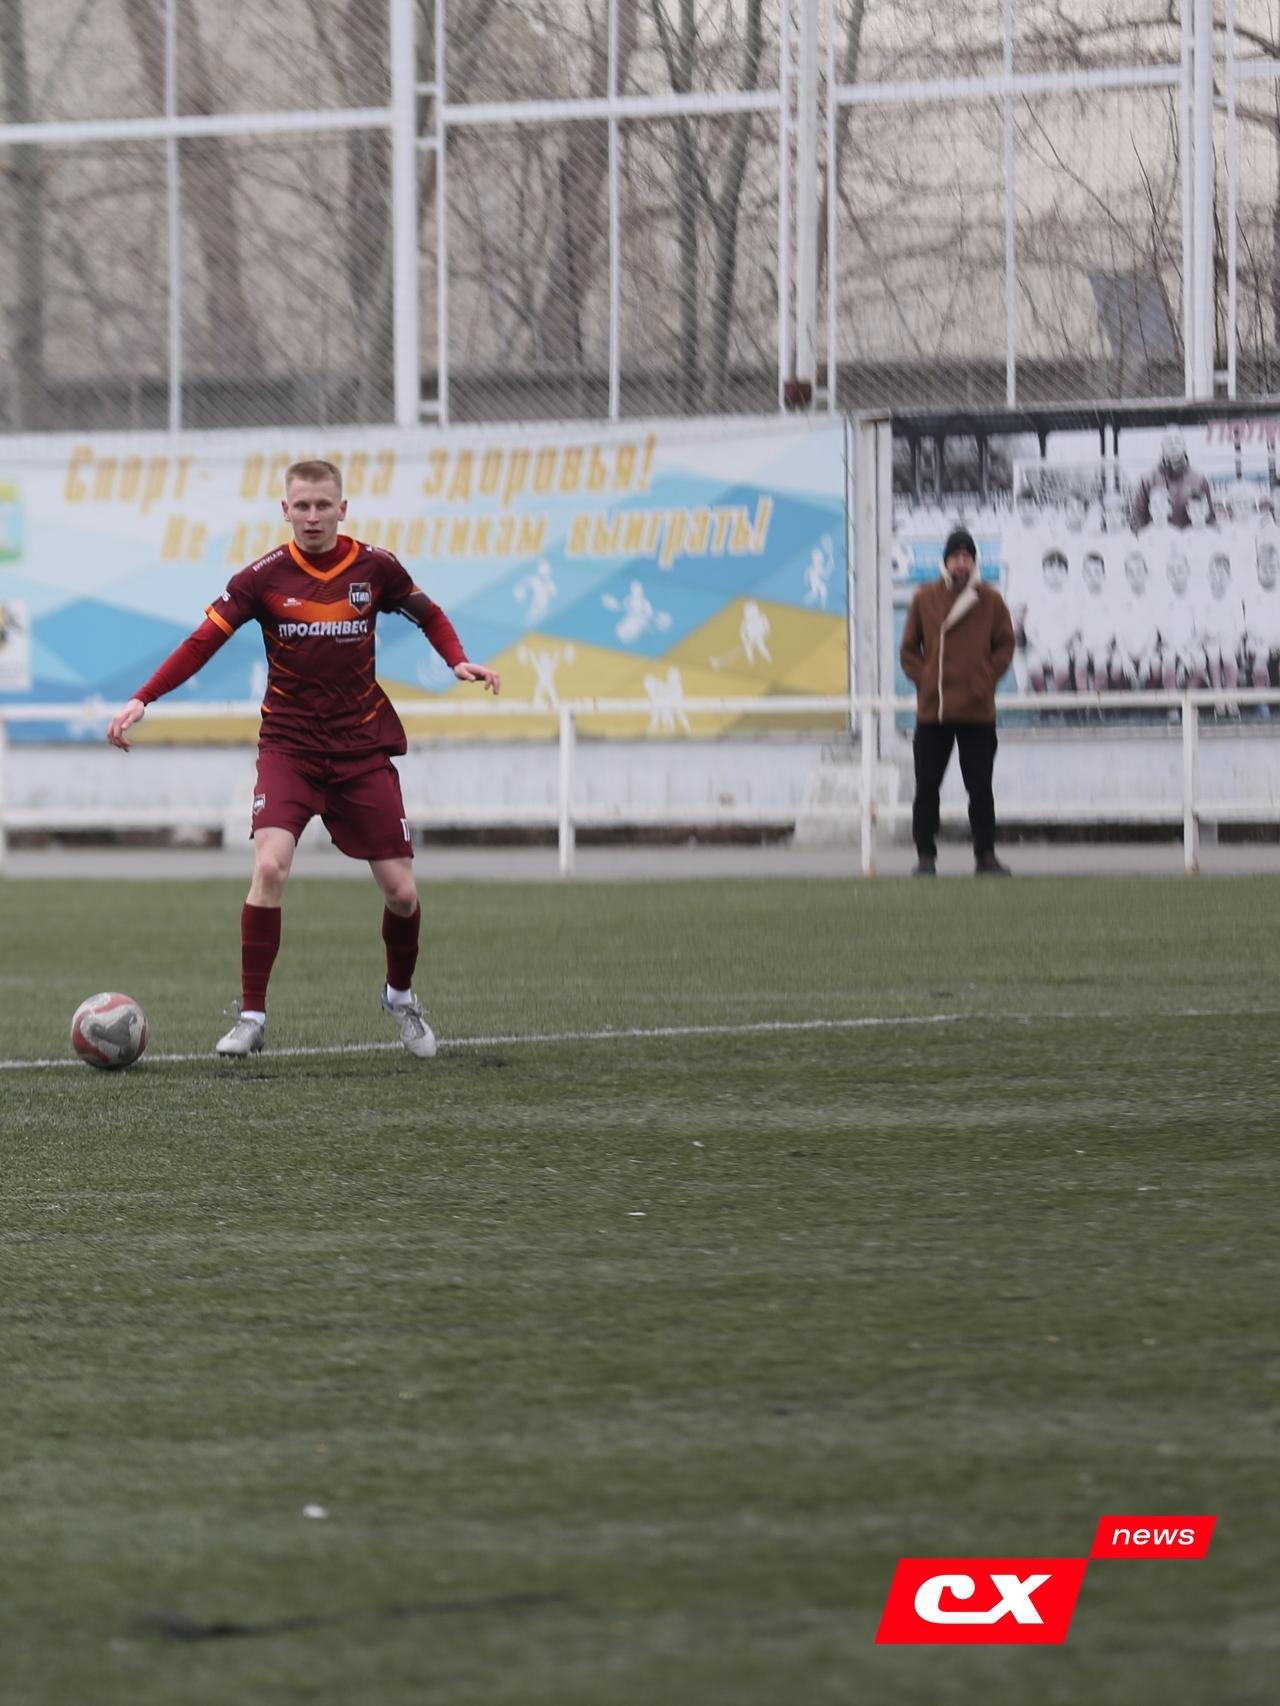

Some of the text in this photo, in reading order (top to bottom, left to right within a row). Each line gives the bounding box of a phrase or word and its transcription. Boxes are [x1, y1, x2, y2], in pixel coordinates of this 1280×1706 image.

[240, 448, 397, 499] осва
[423, 432, 657, 508] здоровья!
[161, 513, 209, 562] Не
[565, 495, 774, 571] выиграть!
